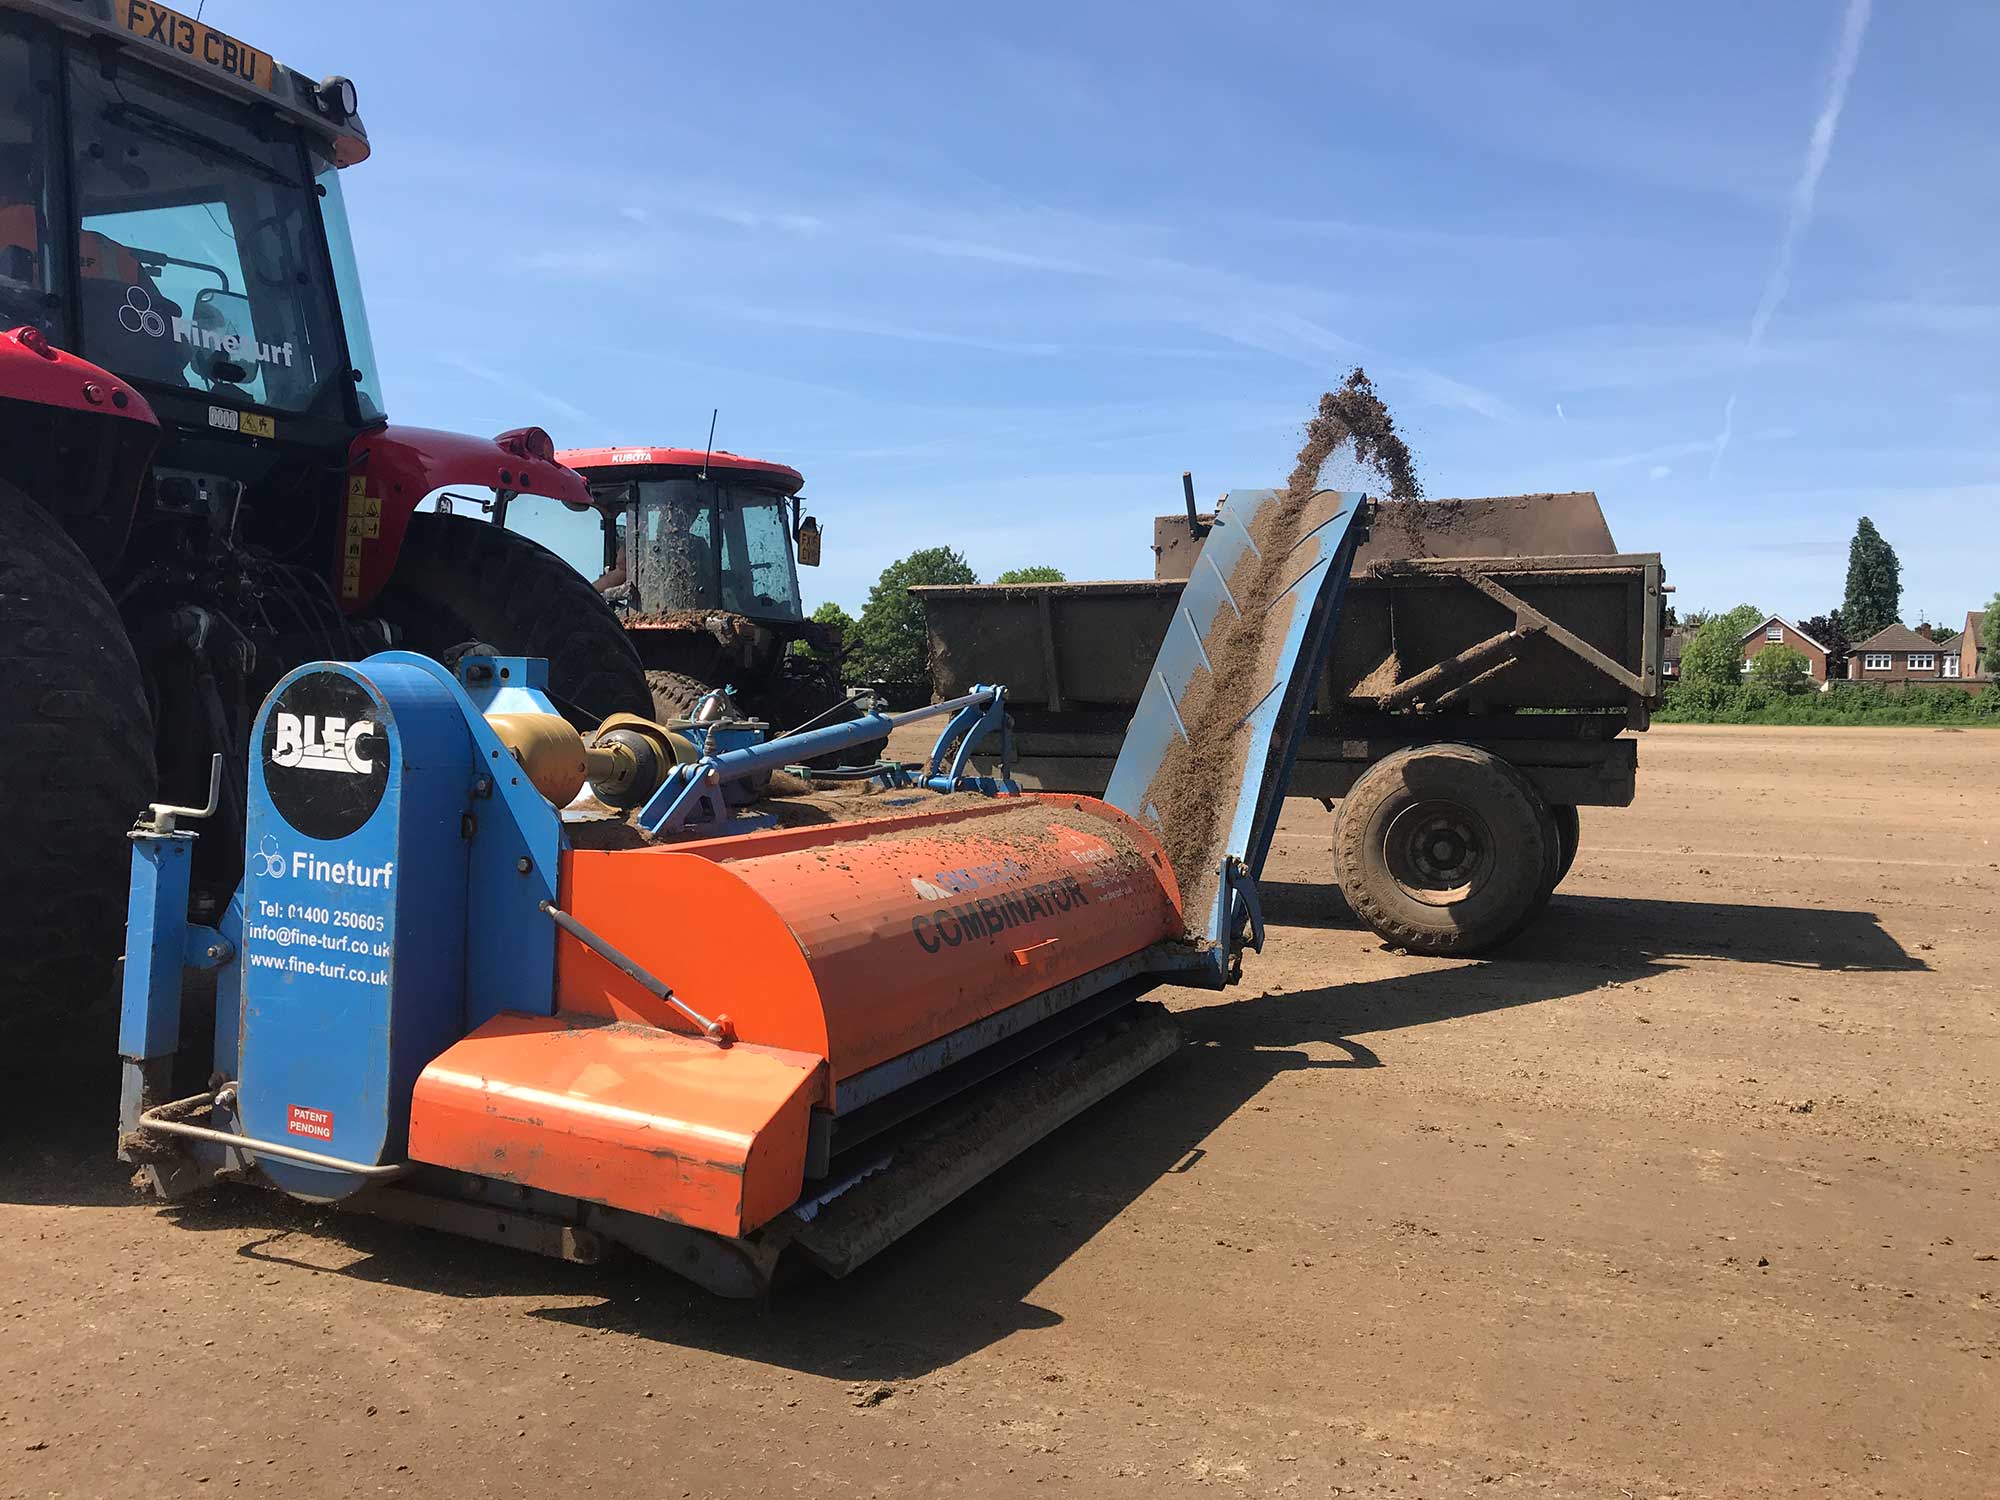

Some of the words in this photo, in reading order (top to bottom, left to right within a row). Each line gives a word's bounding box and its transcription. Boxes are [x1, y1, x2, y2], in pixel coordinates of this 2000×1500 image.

[128, 0, 195, 54] FX13
[203, 32, 256, 82] CBU
[612, 453, 652, 463] KUBOTA
[272, 713, 374, 774] BLEC
[292, 851, 394, 889] Fineturf
[259, 900, 283, 918] Tel:
[288, 904, 329, 924] 01400
[333, 910, 384, 932] 250605
[912, 876, 1088, 953] COMBINATOR
[249, 923, 390, 957] info@fine-turf.co.uk
[250, 954, 388, 985] www.fine-turf.co.uk
[290, 1120, 330, 1138] PENDING
[294, 1108, 328, 1124] PATENT
